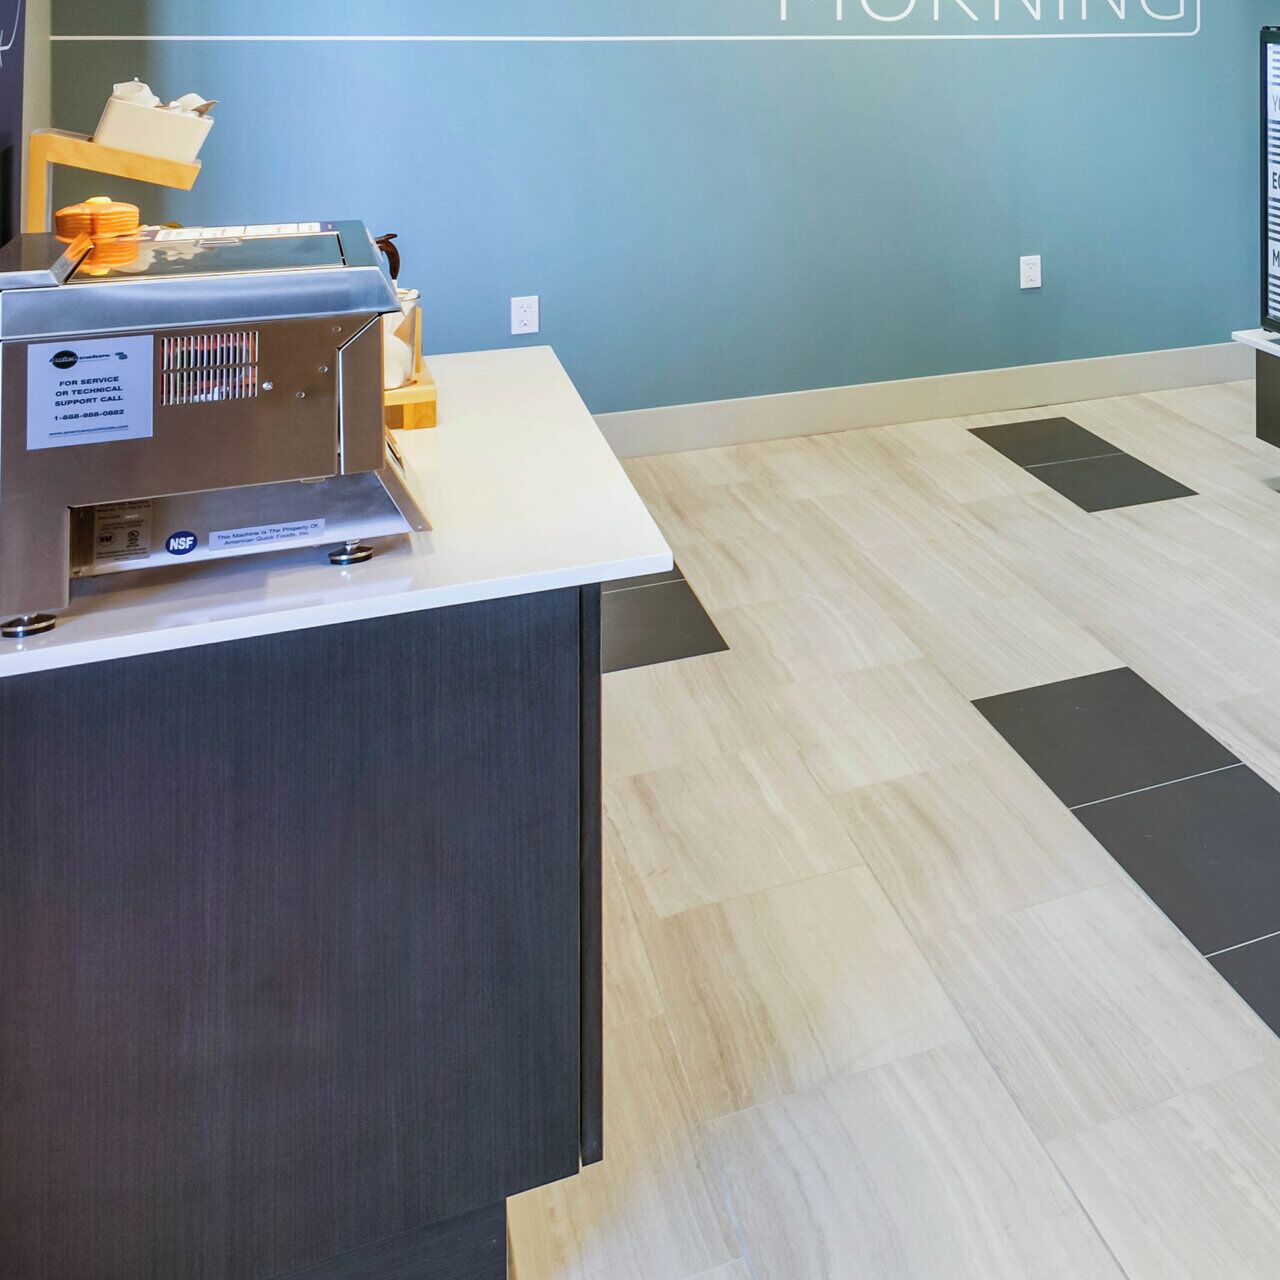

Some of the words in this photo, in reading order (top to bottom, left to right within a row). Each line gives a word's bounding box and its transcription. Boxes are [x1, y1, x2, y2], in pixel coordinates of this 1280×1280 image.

[59, 379, 78, 387] FOR
[80, 376, 120, 385] SERVICE
[72, 384, 124, 396] TECHNICAL
[54, 396, 97, 407] SUPPORT
[100, 394, 124, 403] CALL
[169, 535, 194, 551] NSF
